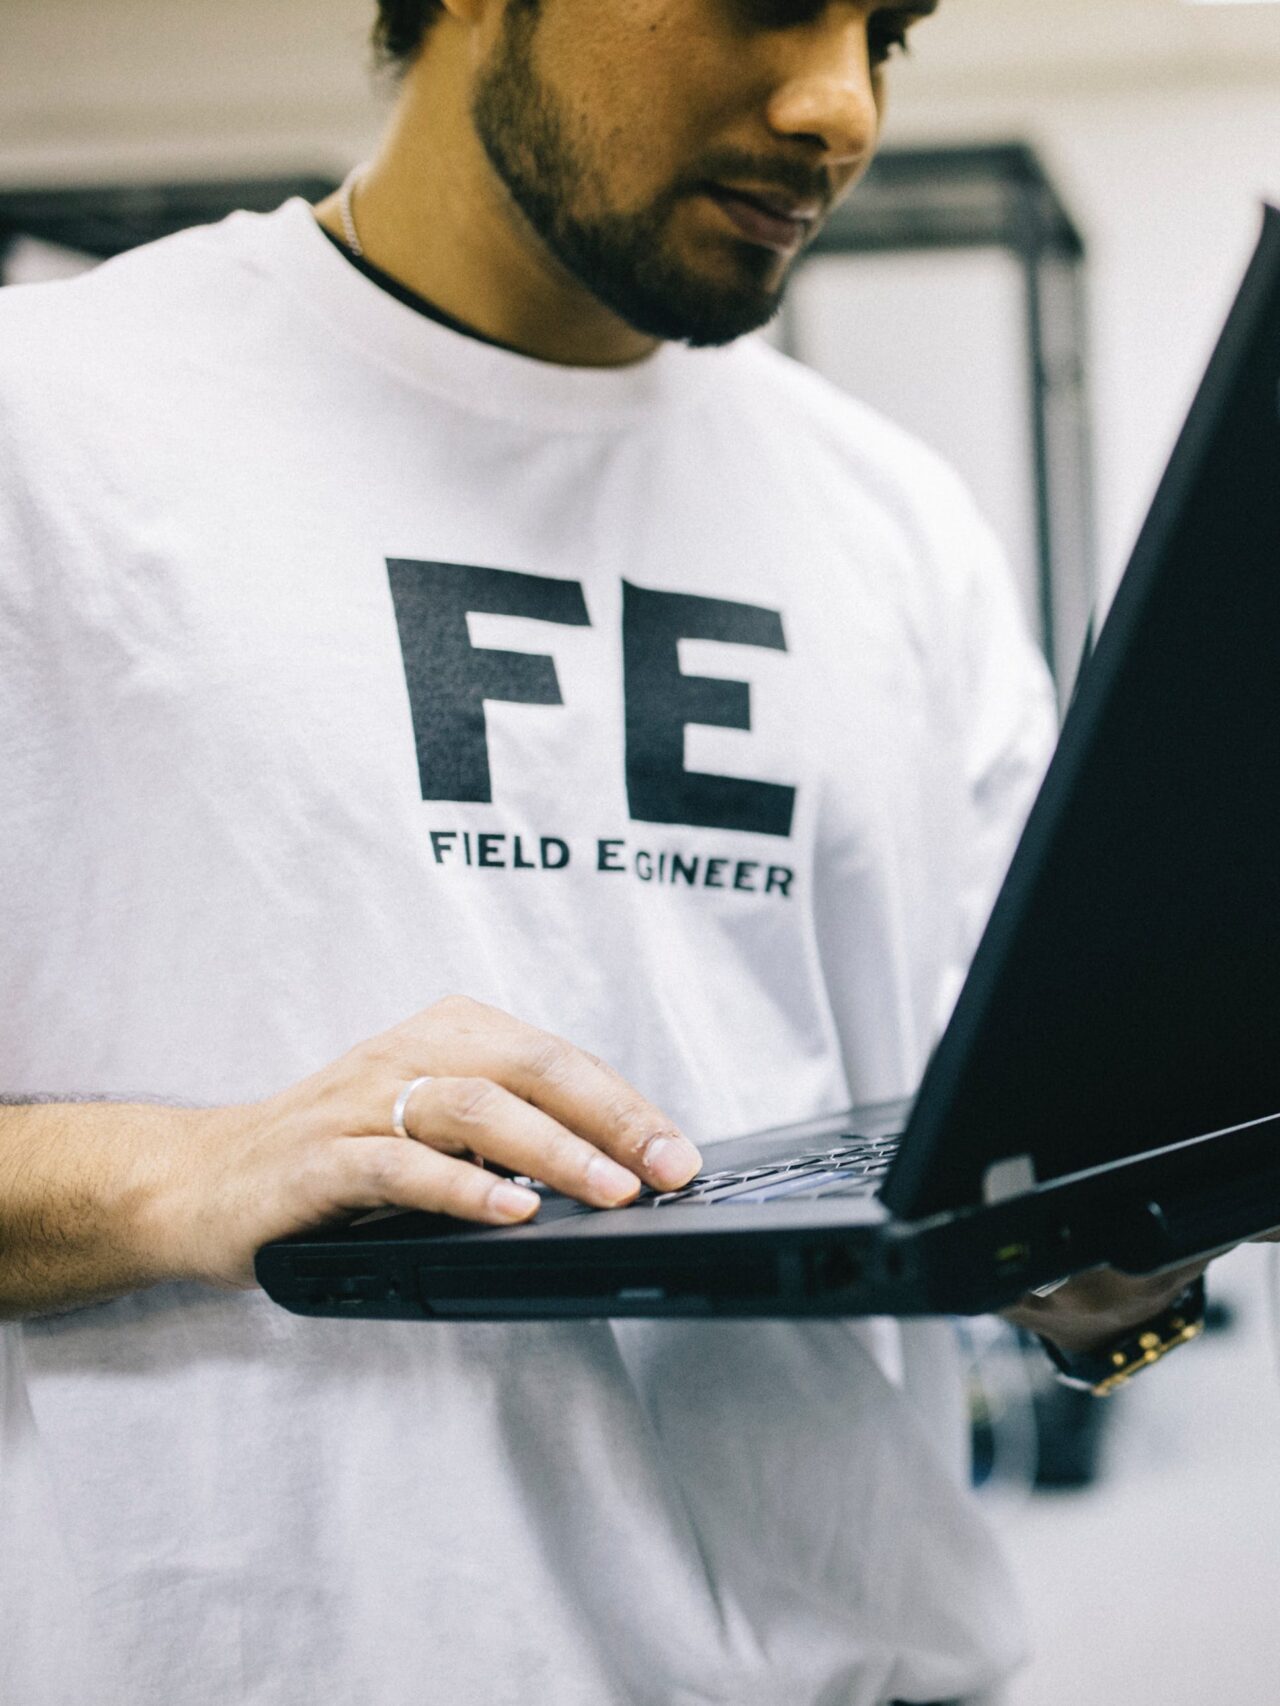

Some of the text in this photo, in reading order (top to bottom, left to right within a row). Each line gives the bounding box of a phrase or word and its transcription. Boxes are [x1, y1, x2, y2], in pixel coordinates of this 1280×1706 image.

[385, 557, 796, 837] FE
[429, 830, 795, 897] FIELD EGINEER
